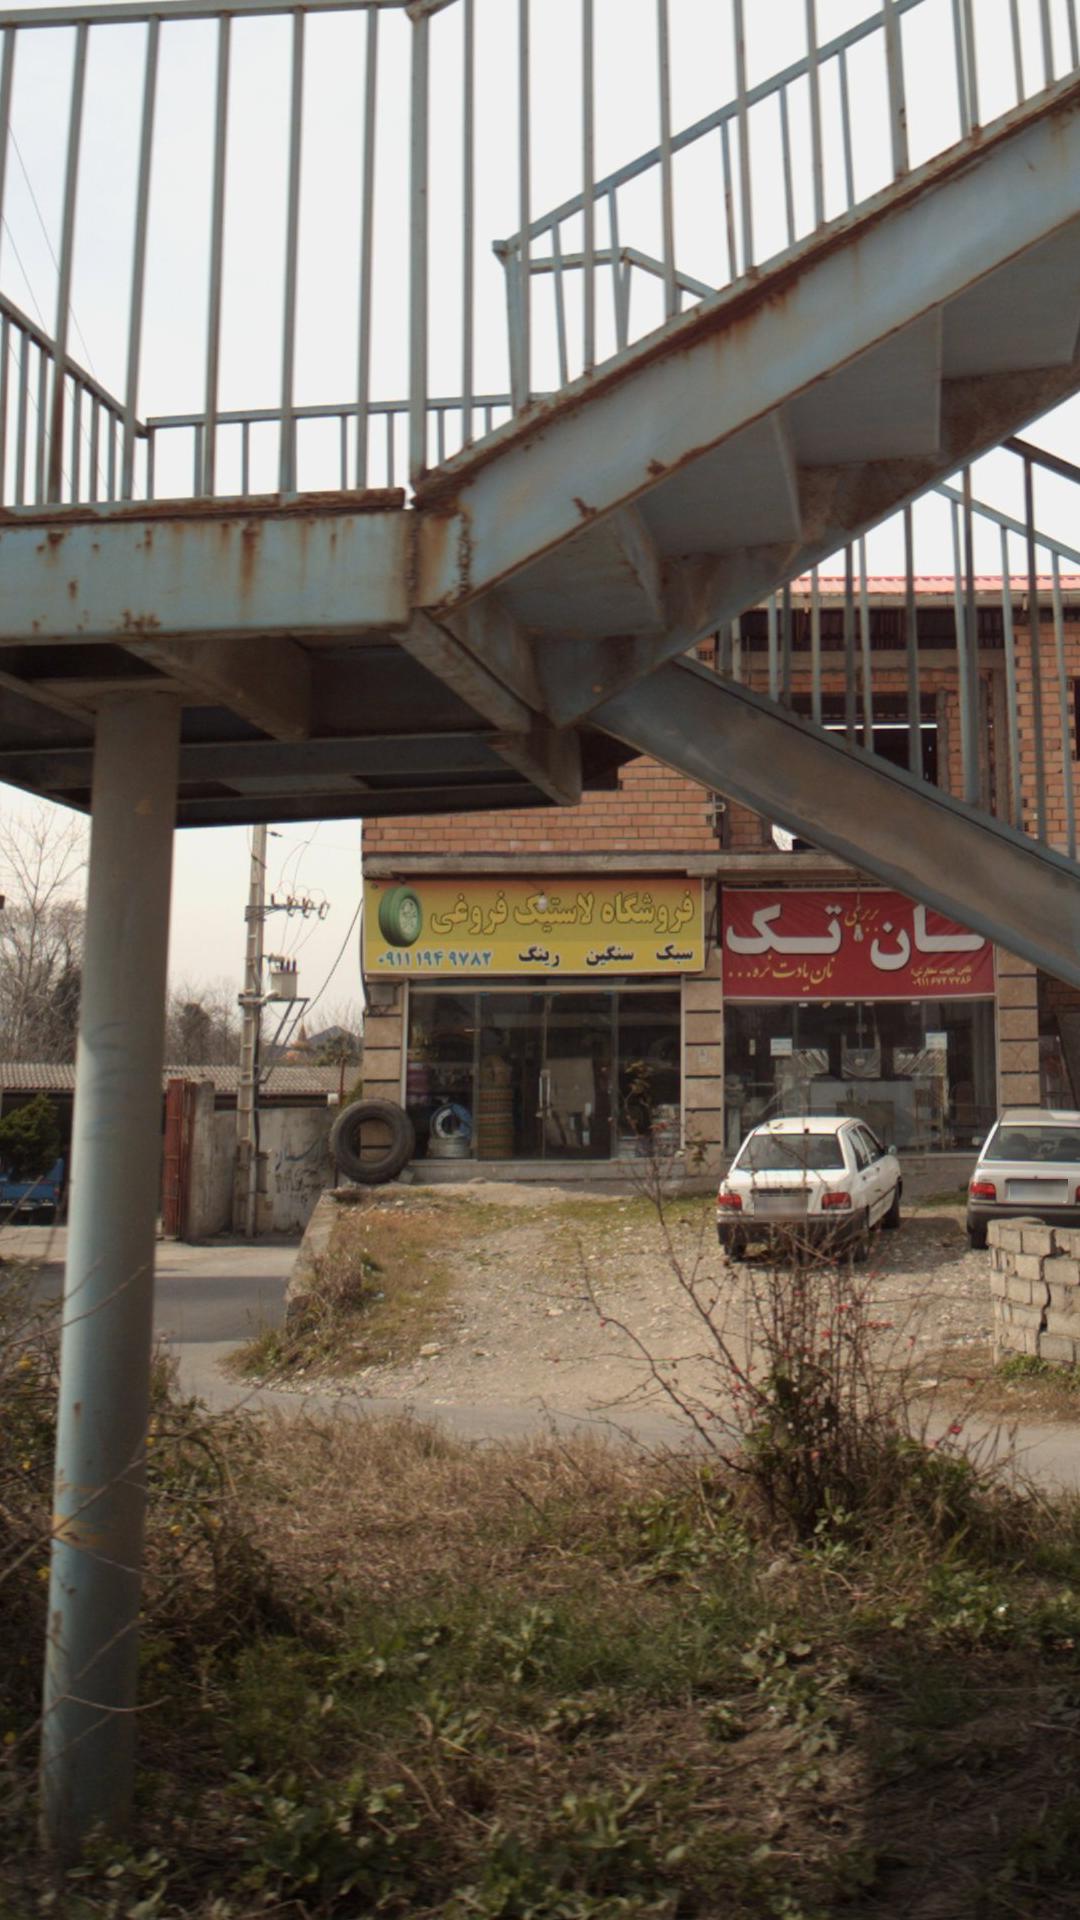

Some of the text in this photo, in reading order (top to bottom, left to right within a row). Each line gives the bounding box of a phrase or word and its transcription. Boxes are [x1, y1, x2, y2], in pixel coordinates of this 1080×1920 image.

[431, 890, 694, 935] فروشگاه لاستیک فروغی
[726, 904, 842, 954] تک
[378, 951, 410, 966] ۰۹۱۱
[518, 944, 692, 967] سبک سنگین رینگ
[772, 962, 810, 992] یادت
[810, 957, 836, 984] نان
